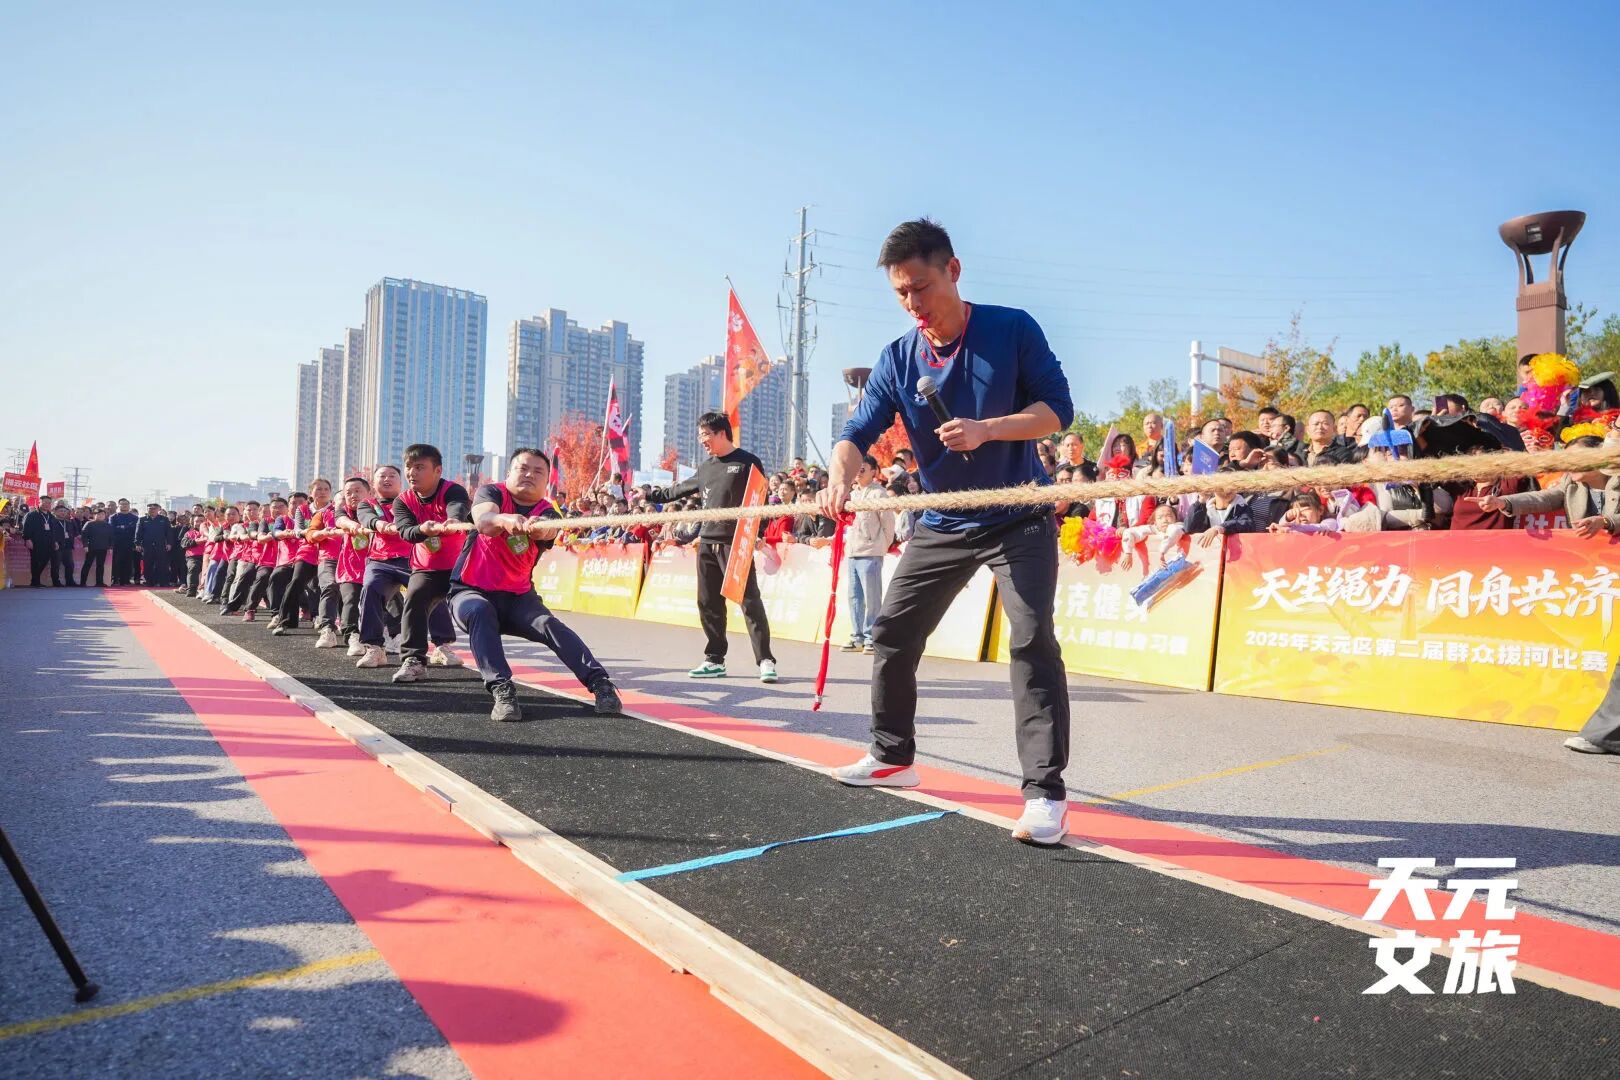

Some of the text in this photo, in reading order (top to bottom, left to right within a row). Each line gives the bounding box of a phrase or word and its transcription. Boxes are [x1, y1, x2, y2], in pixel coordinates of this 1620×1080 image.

[1425, 565, 1620, 645] 同舟共济
[1245, 630, 1608, 672] 2025年天元区第二届群众拔河比赛
